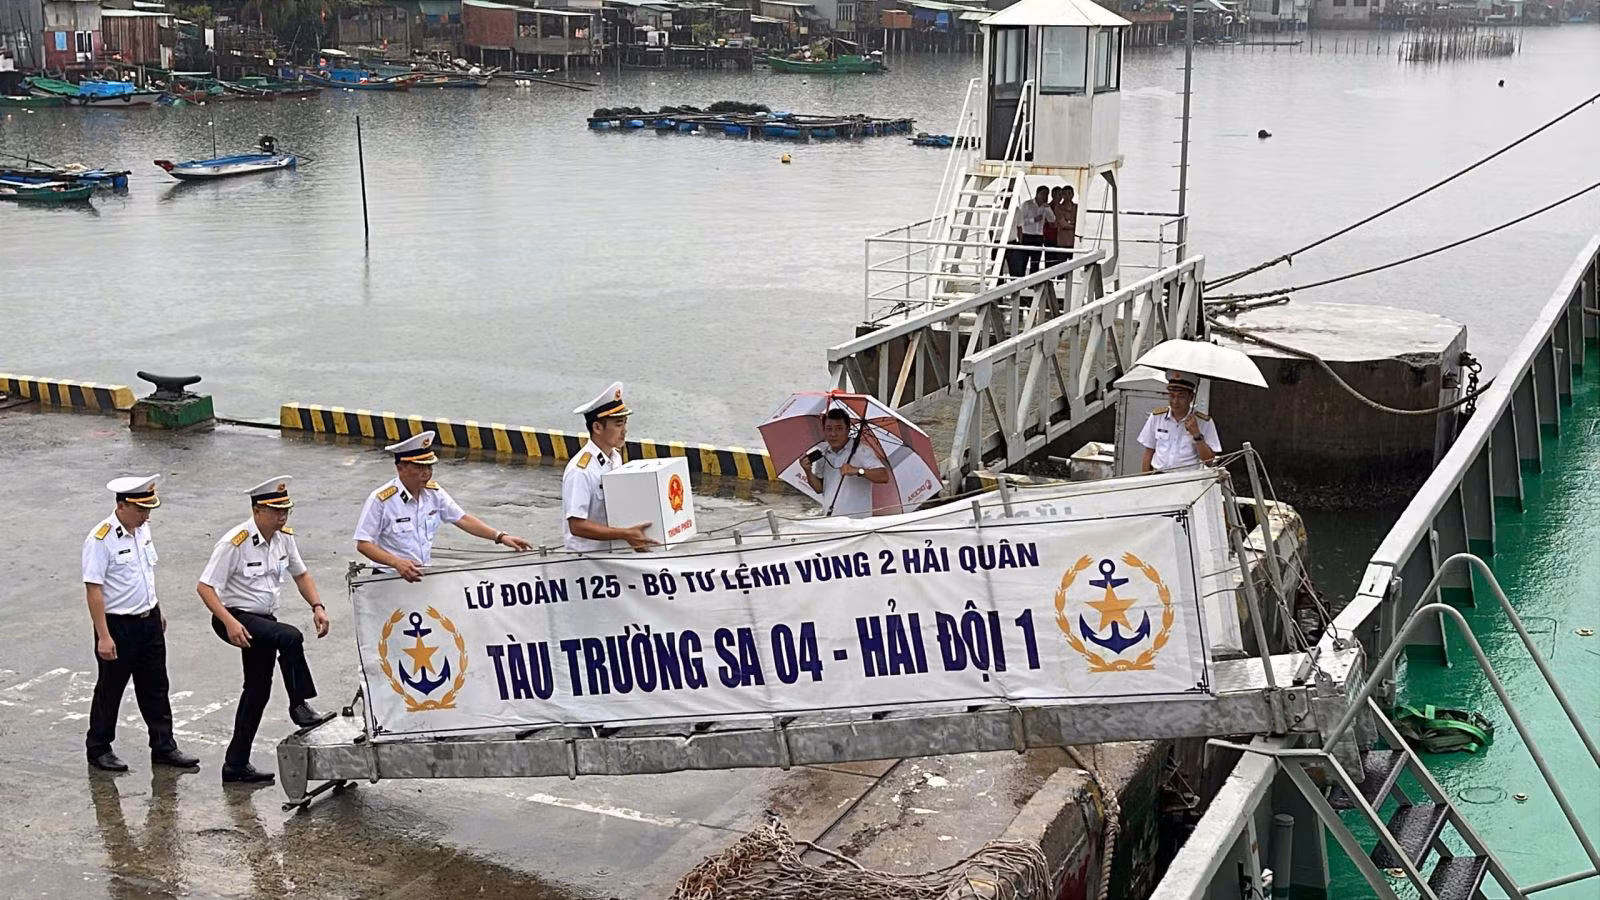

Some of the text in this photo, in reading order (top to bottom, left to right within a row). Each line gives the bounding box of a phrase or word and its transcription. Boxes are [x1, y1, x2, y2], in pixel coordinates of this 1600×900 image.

[464, 580, 495, 610] LỮ
[500, 575, 569, 607] ĐOÀN
[575, 574, 621, 601] 125
[641, 568, 677, 601] BỘ
[680, 568, 716, 593] TƯ
[720, 562, 791, 595] LỆNH
[795, 552, 872, 583] VÙNG
[878, 549, 897, 575] 2
[902, 539, 950, 574] HẢI
[958, 538, 1040, 574] QUÂN
[485, 634, 554, 701] TÀU
[559, 623, 709, 697] TRƯỜNG
[713, 627, 766, 689] SA
[770, 621, 824, 685] 04
[855, 598, 929, 678] HẢI
[934, 599, 1007, 683] ĐỘI
[1014, 608, 1041, 670] 1
